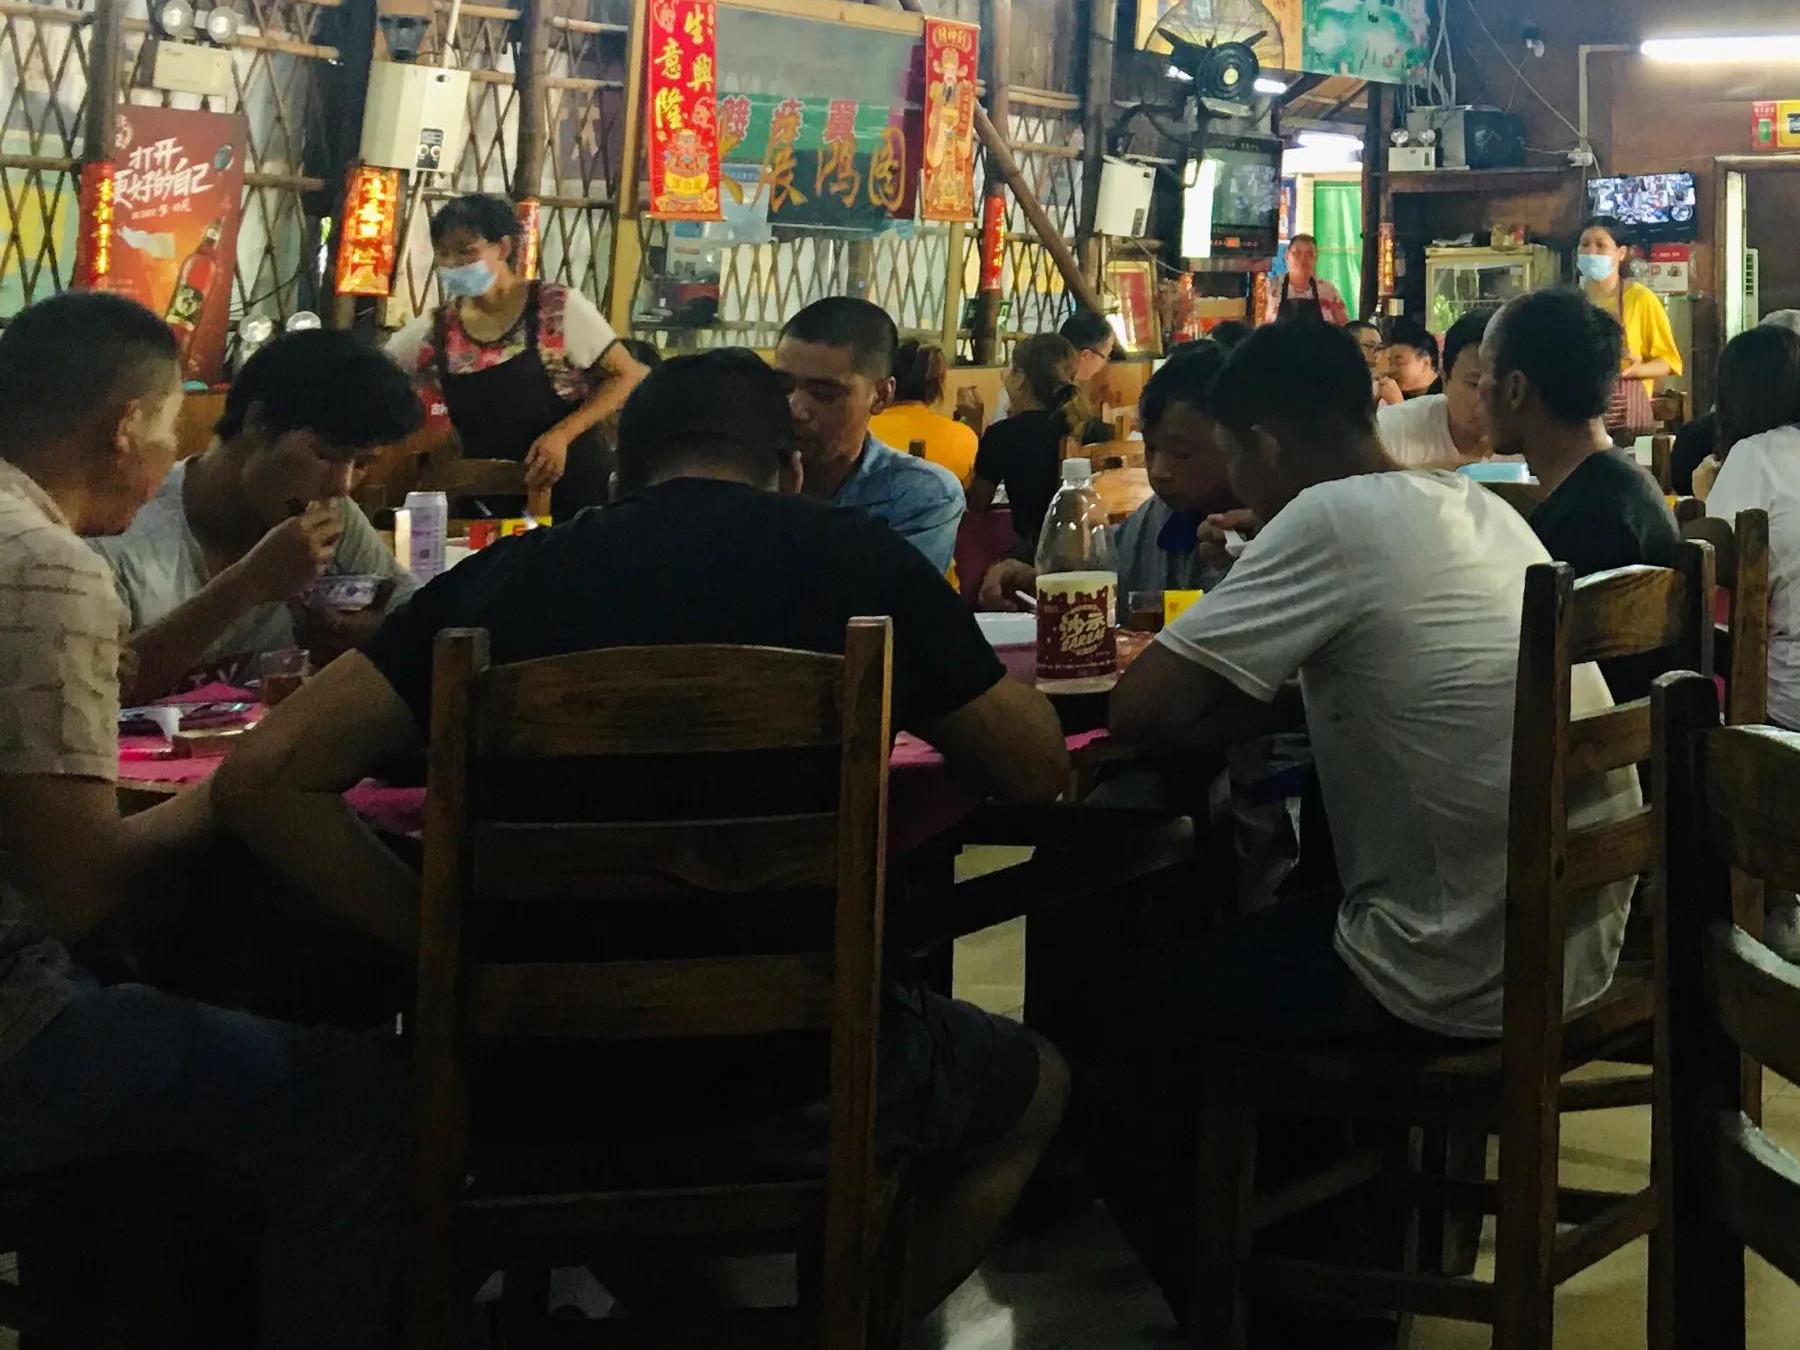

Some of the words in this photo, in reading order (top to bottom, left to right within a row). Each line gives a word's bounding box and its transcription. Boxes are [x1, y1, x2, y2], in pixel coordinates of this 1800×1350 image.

[128, 137, 184, 171] 打开
[113, 157, 215, 209] 更好的自己
